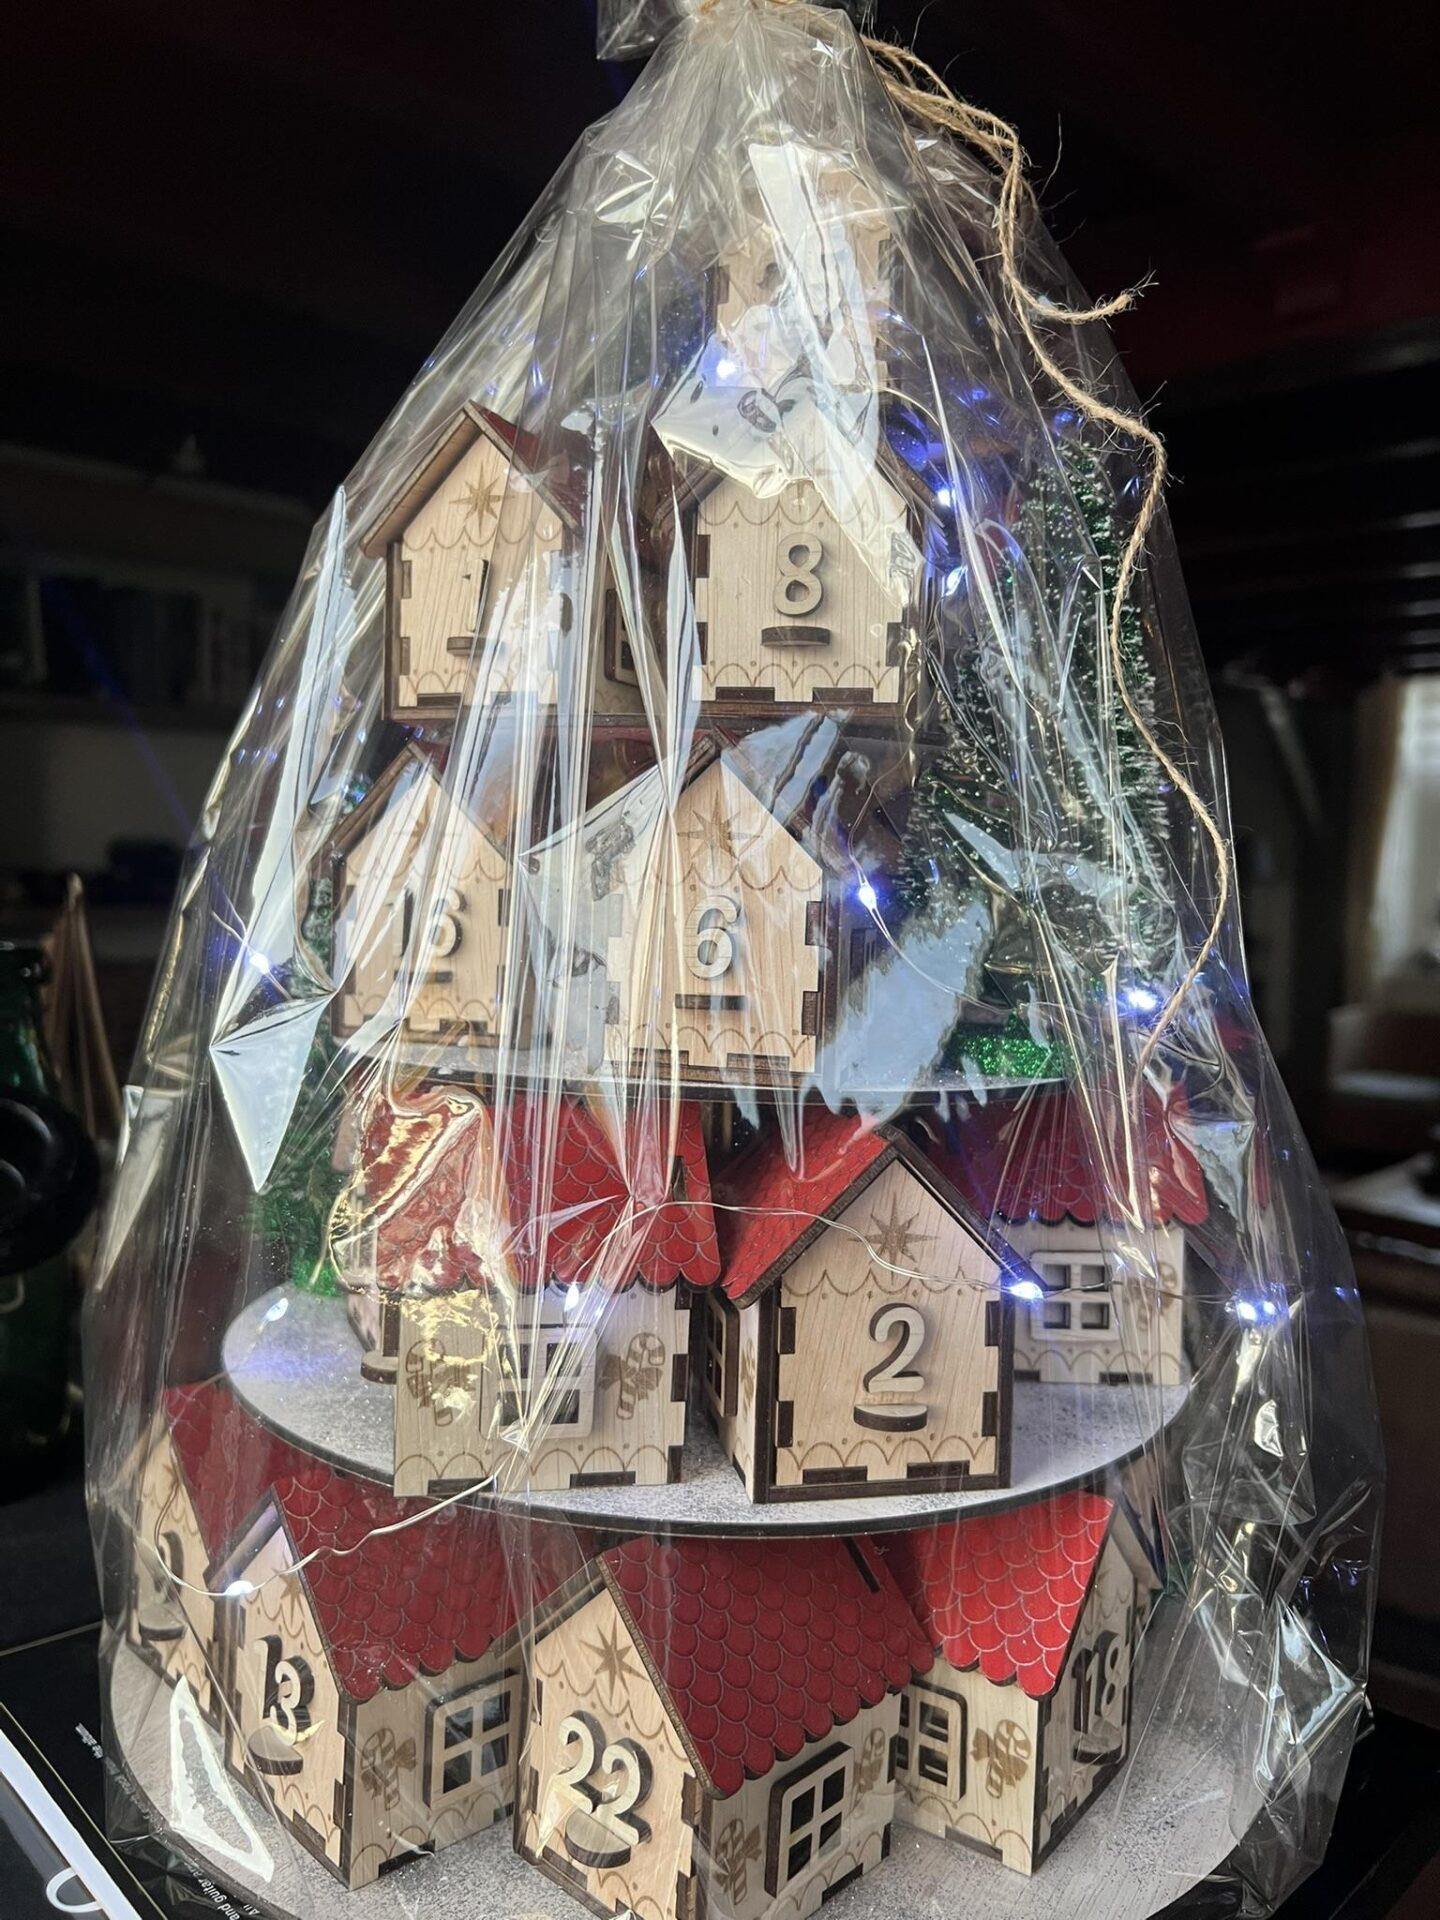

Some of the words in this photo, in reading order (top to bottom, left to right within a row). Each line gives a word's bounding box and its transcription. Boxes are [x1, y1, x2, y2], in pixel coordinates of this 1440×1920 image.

[773, 532, 824, 617] 8
[682, 895, 740, 980] 6
[863, 1303, 925, 1393] 2
[252, 1634, 315, 1746] 13
[1072, 1630, 1130, 1735] 18
[554, 1710, 653, 1848] 22
